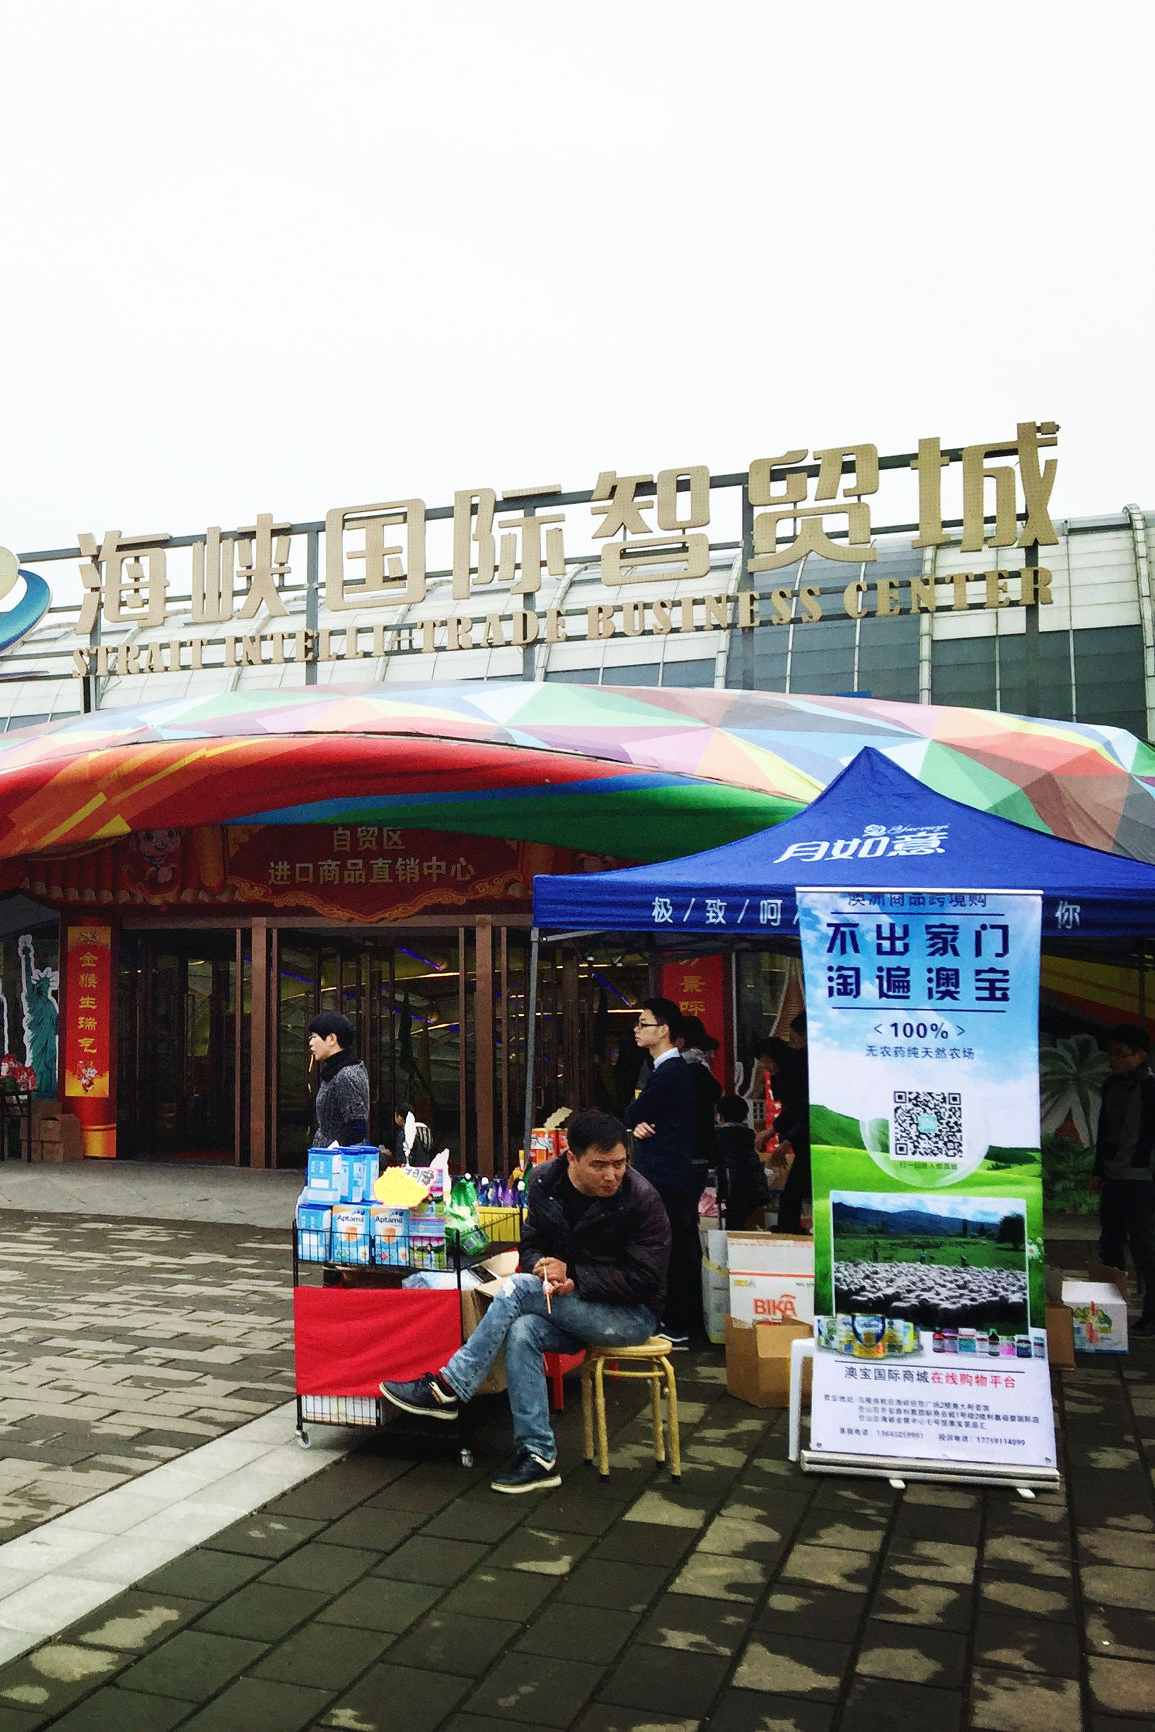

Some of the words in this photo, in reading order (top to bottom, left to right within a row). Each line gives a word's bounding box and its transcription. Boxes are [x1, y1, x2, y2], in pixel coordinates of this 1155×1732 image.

[75, 421, 1061, 635] 海峡国际智贸城
[72, 638, 207, 679] STRAIT
[585, 585, 823, 640] BUSINESS
[843, 566, 1054, 619] CENTER
[333, 826, 406, 852] 自贸区
[268, 856, 476, 886] 进口商品直销中心
[1054, 900, 1081, 929] 你
[826, 922, 1010, 958] 不出家门
[826, 965, 1011, 1002] 淘遍澳宝
[865, 1045, 975, 1060] 无农药纯天然农场
[336, 1214, 365, 1223] Aptamil
[375, 1216, 403, 1224] Aptamil
[753, 1296, 798, 1318] BIKA
